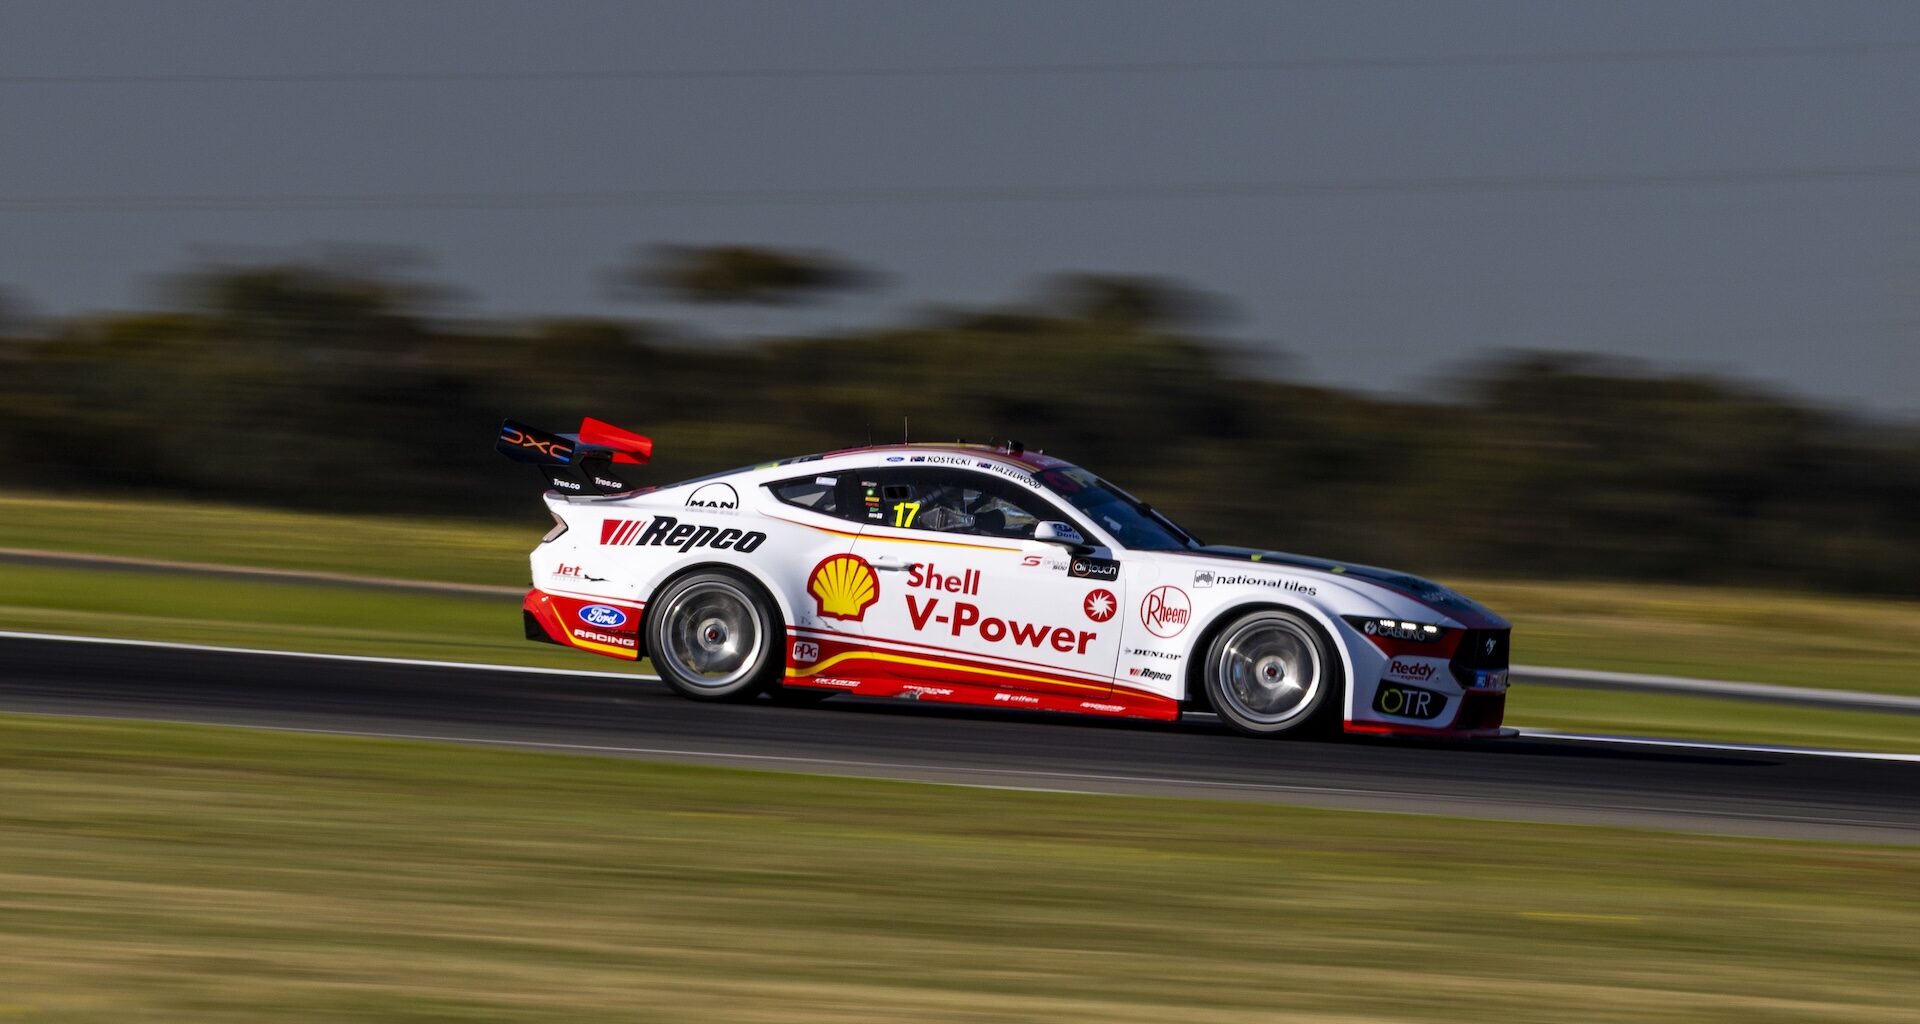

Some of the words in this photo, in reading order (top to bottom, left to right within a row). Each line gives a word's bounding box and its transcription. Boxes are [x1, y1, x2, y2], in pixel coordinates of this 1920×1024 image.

[500, 426, 573, 463] DXC
[927, 456, 971, 466] KOSTECKI
[553, 478, 581, 490] Tree.co
[594, 477, 622, 489] Tree.co
[991, 464, 1042, 489] HAZELWOOD
[689, 500, 734, 509] MAN
[893, 502, 921, 528] 17
[635, 515, 767, 554] Repco
[552, 563, 582, 577] Jet
[906, 563, 981, 596] Shell
[1216, 575, 1282, 588] national
[1284, 581, 1318, 597] tiles
[587, 606, 617, 625] Ford
[1146, 586, 1188, 629] Rheem
[905, 594, 1097, 655] V-Power
[1377, 624, 1426, 642] CABLING
[573, 628, 635, 647] RACING
[1133, 648, 1182, 661] DUNLOP
[1140, 667, 1173, 682] Repco
[1390, 660, 1437, 681] Reddy
[1381, 688, 1431, 716] OTR
